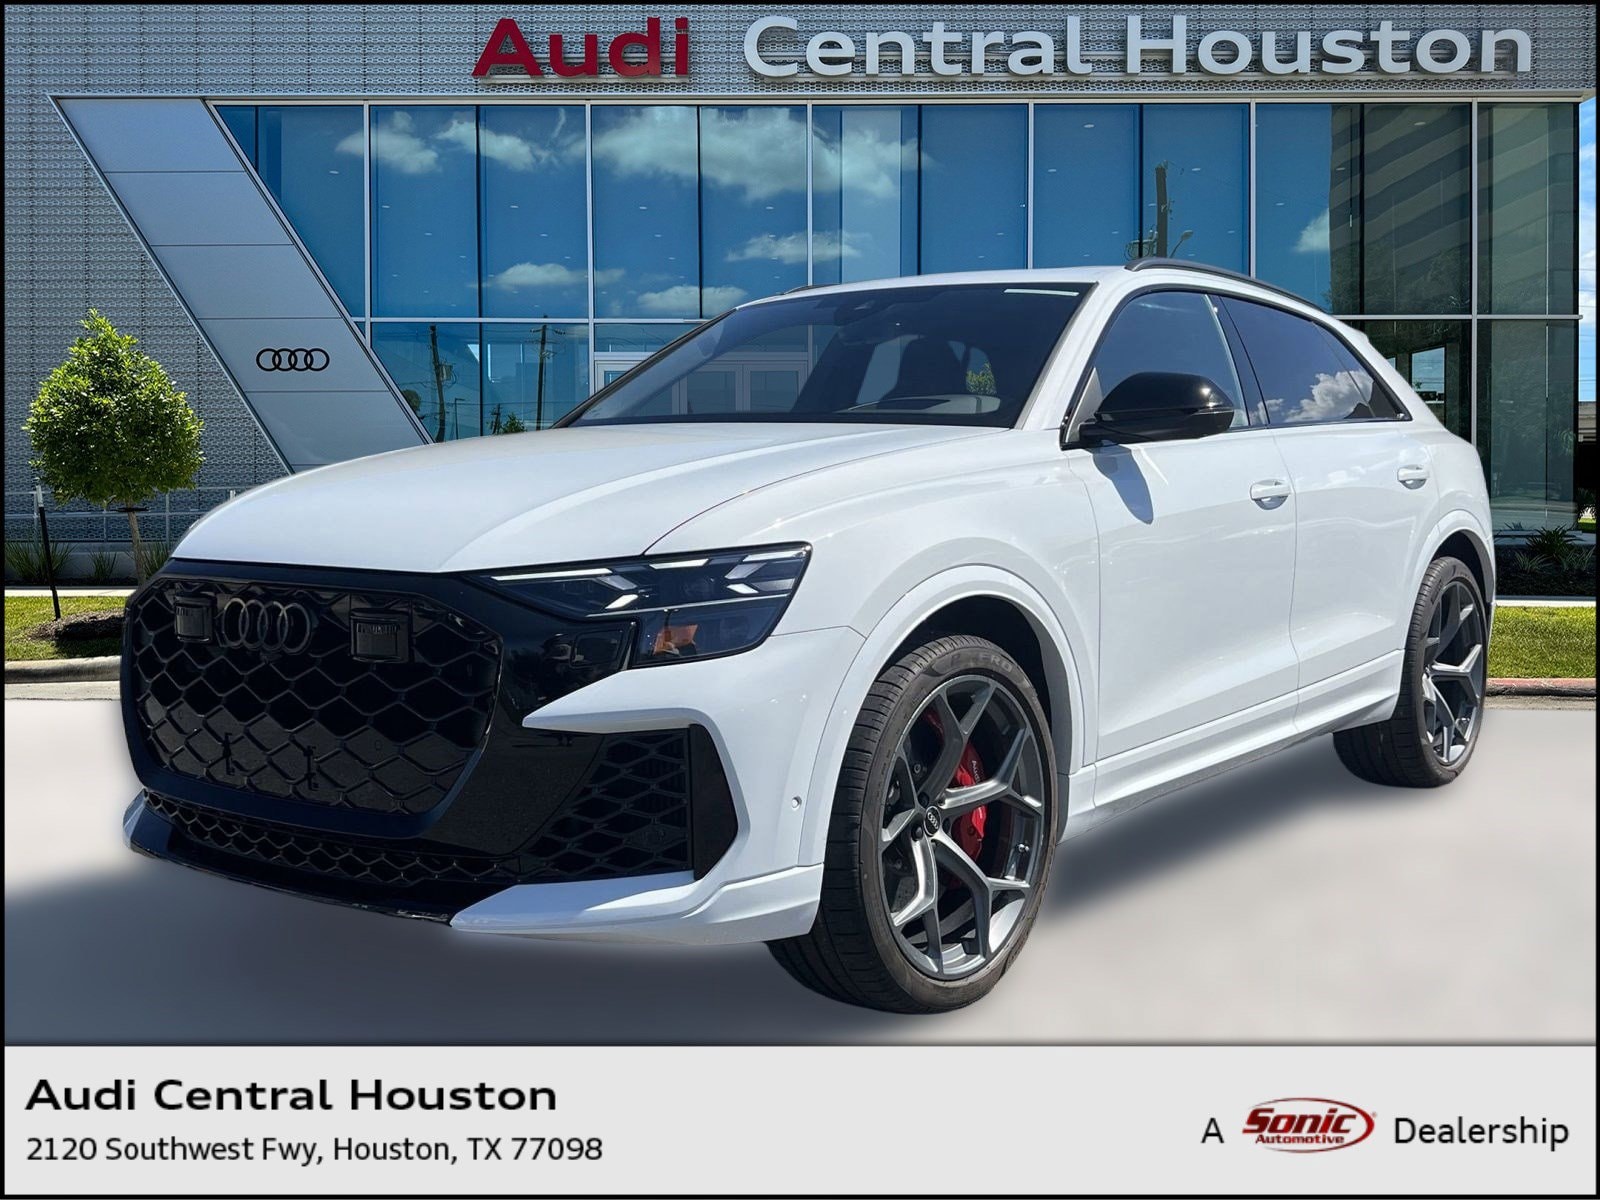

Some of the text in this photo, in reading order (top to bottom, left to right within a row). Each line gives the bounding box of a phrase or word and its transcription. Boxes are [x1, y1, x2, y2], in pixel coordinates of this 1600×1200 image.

[471, 15, 1532, 78] Audi Central Houston
